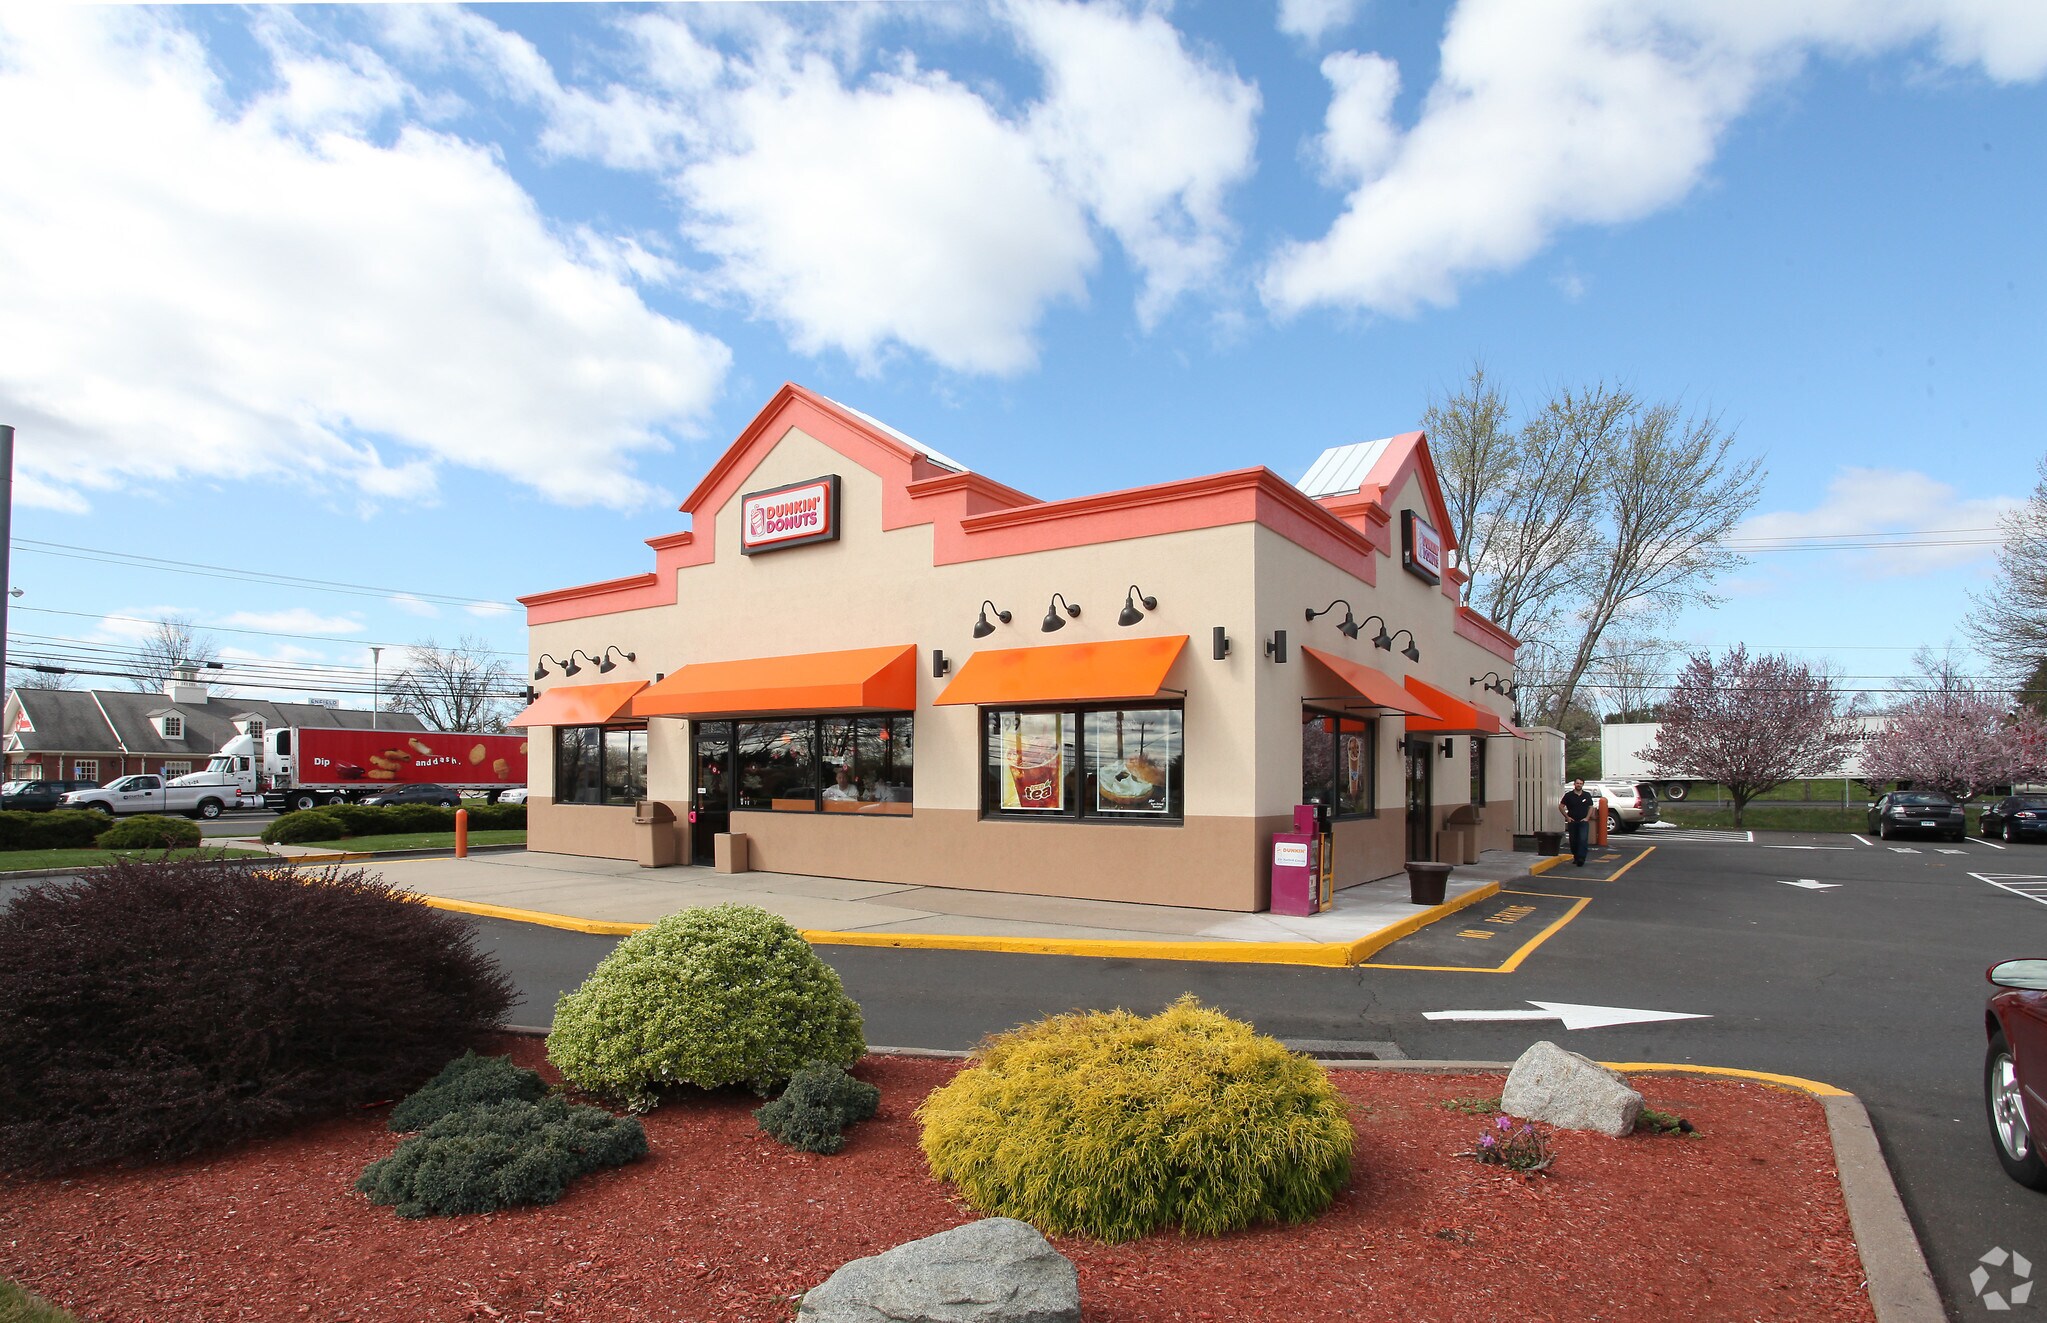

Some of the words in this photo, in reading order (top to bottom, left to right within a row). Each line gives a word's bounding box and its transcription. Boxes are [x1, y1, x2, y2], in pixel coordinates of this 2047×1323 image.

[766, 496, 820, 520] DUNKIN'
[766, 511, 818, 533] DONUTS
[314, 757, 331, 767] Dip
[415, 758, 432, 767] and
[1025, 786, 1052, 800] tea
[1456, 929, 1496, 940] NO
